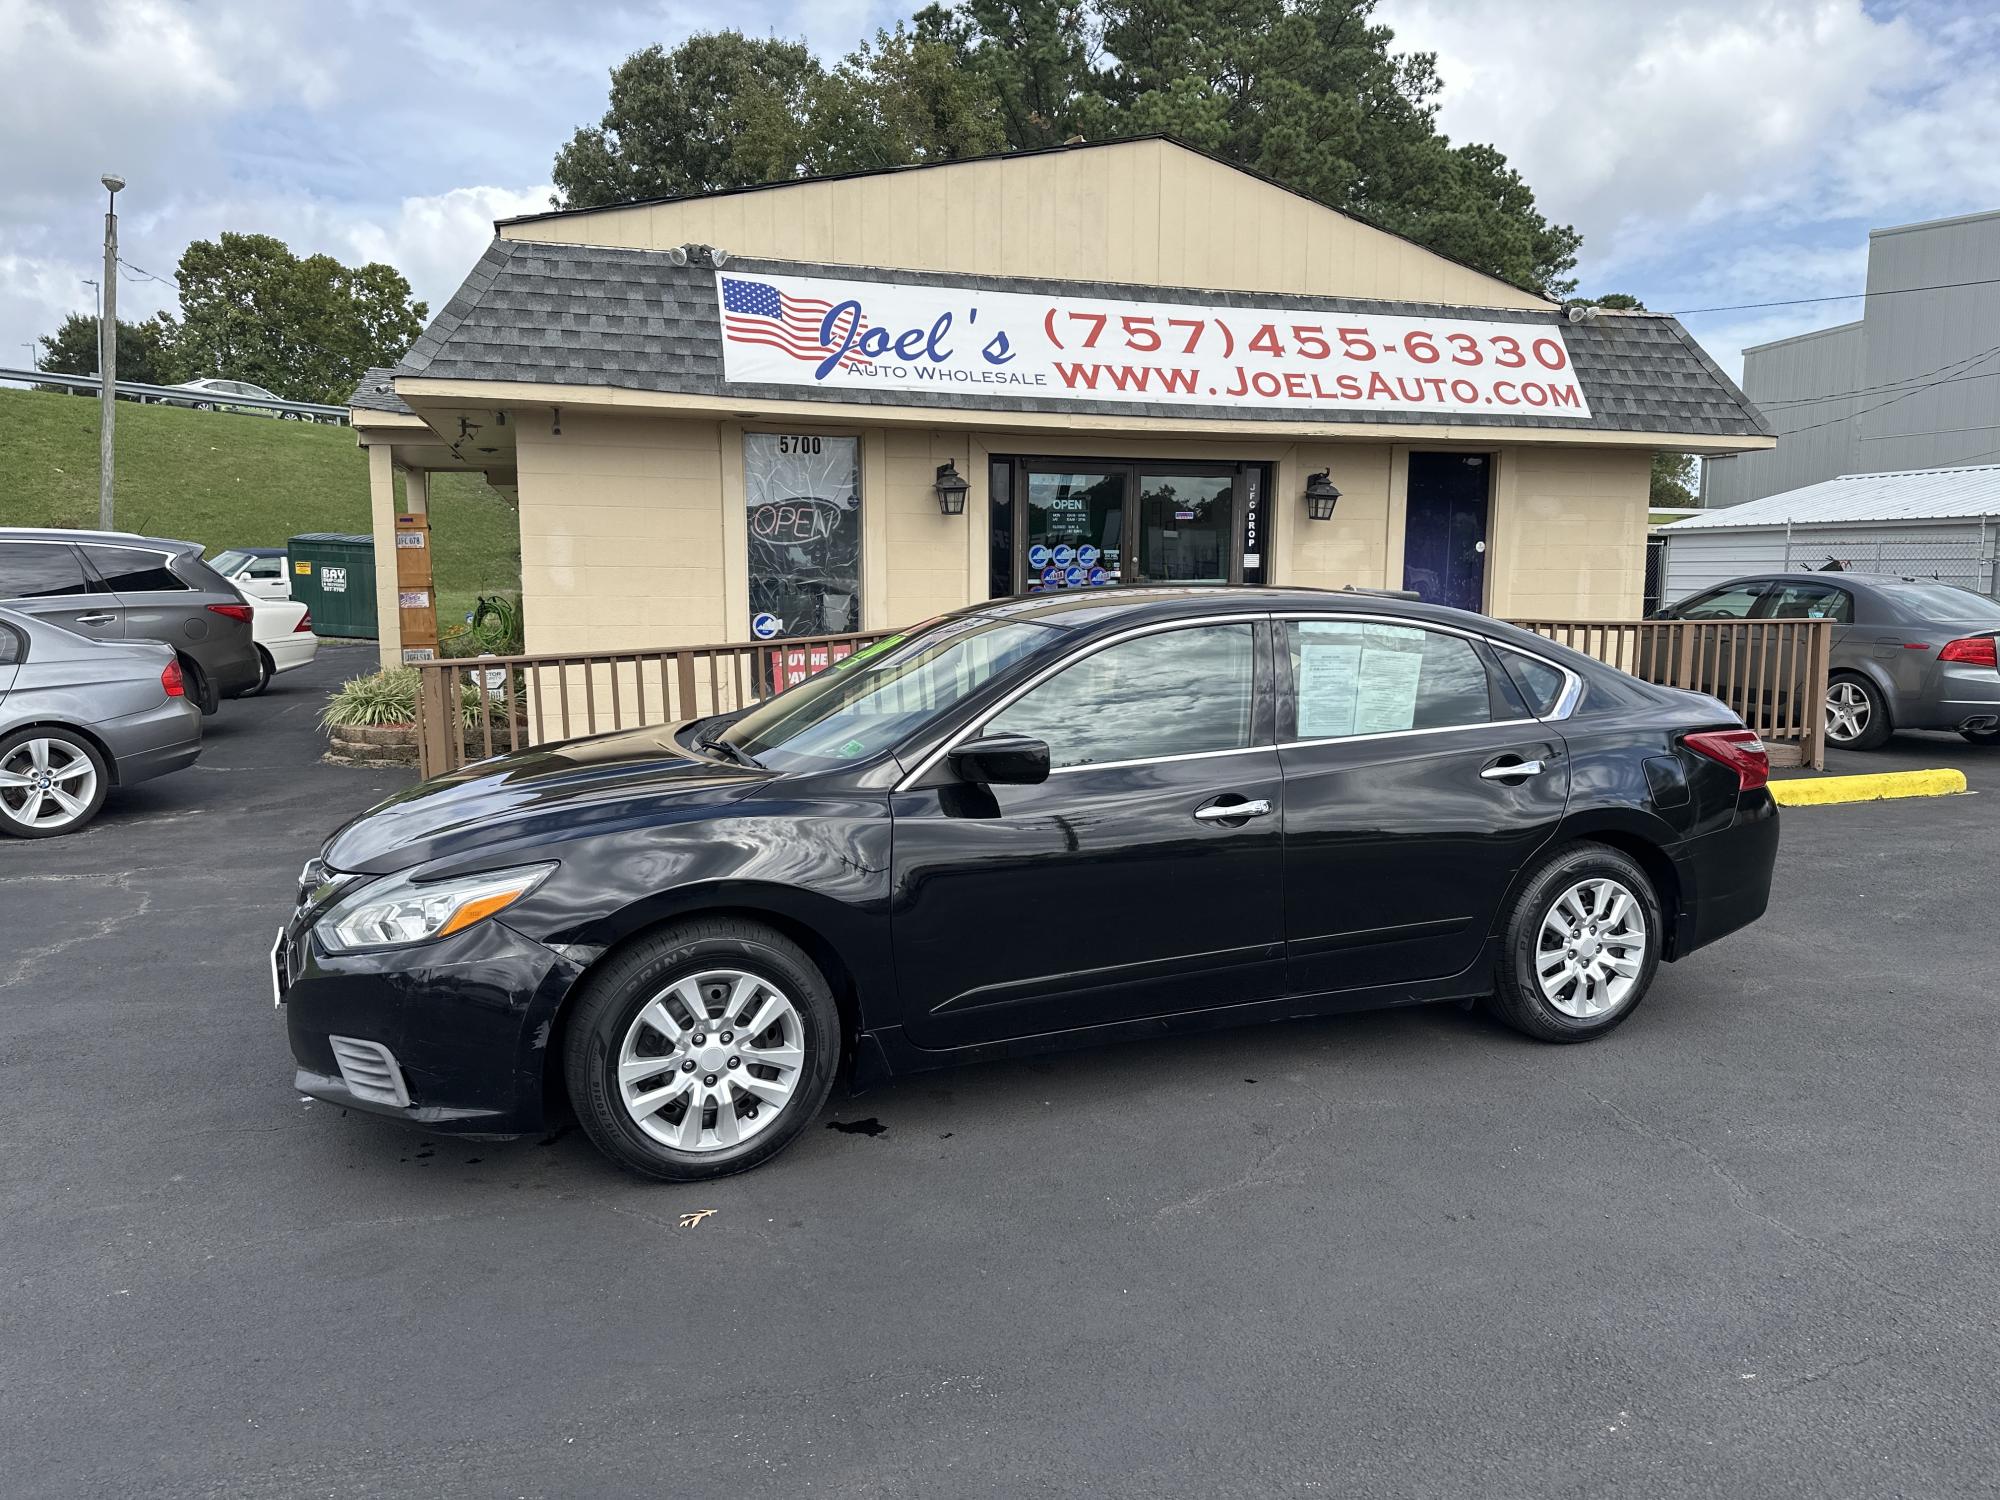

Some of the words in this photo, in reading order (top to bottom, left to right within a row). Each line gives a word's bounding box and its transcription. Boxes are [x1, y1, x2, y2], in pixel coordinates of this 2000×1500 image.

[815, 299, 1016, 381] Joel's
[1044, 307, 1567, 371] (757)455-6330
[847, 361, 907, 379] AUTO
[914, 365, 1048, 386] WHOLESALE
[780, 436, 821, 455] 5700
[1052, 499, 1083, 510] OPEN
[754, 505, 835, 539] OPEN
[1248, 512, 1257, 547] DROP
[323, 568, 345, 579] BAY
